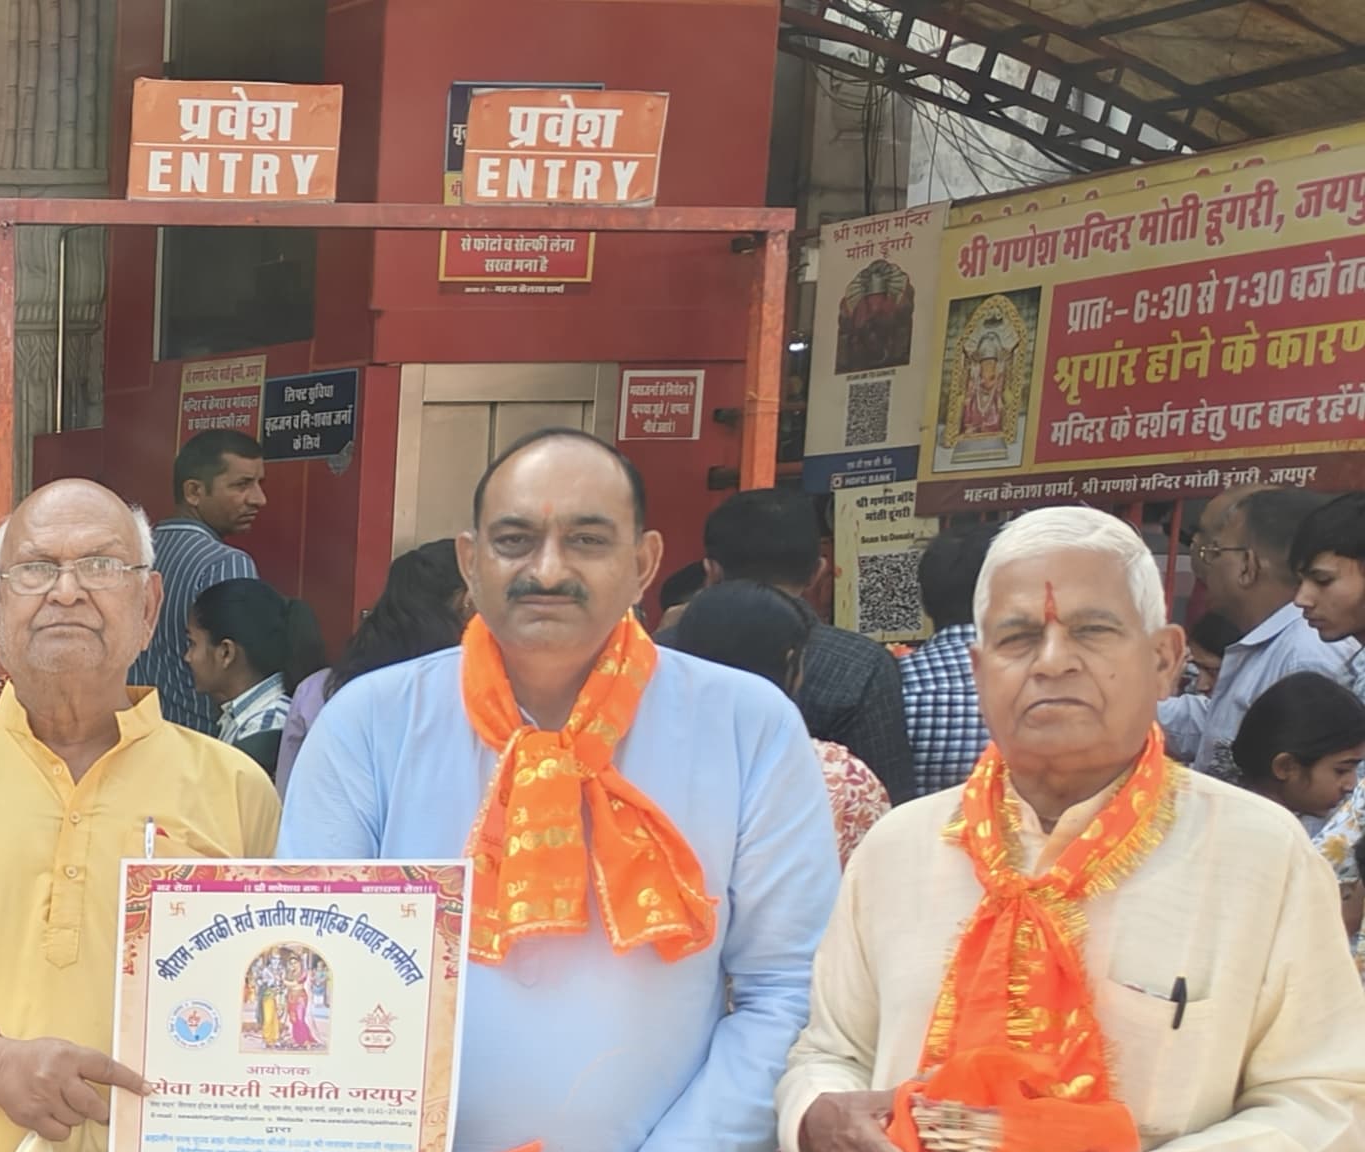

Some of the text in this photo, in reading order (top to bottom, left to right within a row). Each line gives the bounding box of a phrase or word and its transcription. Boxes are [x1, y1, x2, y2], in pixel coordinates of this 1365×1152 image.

[178, 87, 298, 141] प्रवेश
[509, 95, 623, 148] प्रवेश
[147, 151, 319, 194] ENTRY
[477, 157, 639, 200] ENTRY
[958, 235, 990, 278] श्री
[993, 224, 1061, 273] गणेश
[1064, 211, 1136, 260] मन्दिर
[1139, 193, 1204, 245] मोती
[1133, 283, 1192, 324] 6:30
[1197, 269, 1220, 315] से
[1223, 269, 1286, 311] 7:30
[1290, 251, 1336, 301] बजे
[1144, 326, 1217, 384] होने
[1221, 320, 1261, 375] के
[1050, 412, 1107, 448] मन्दिर
[1110, 406, 1135, 441] के
[1135, 401, 1187, 440] दर्शन
[1190, 398, 1227, 442] हेतु
[1229, 401, 1265, 432] पट
[1267, 396, 1314, 428] बन्द
[964, 487, 999, 502] महन्त
[1000, 482, 1043, 500] कैलाश
[1081, 478, 1100, 495] श्री
[1140, 472, 1181, 491] मन्दिर
[1184, 469, 1221, 488] मोती
[233, 904, 254, 933] सर्व
[257, 900, 296, 927] जातीय
[300, 904, 352, 936] सामूहिक
[349, 914, 388, 950] विवाह
[381, 941, 424, 986] सम्मेलन
[146, 1078, 417, 1107] सेवा भारती समिति जयपुर
